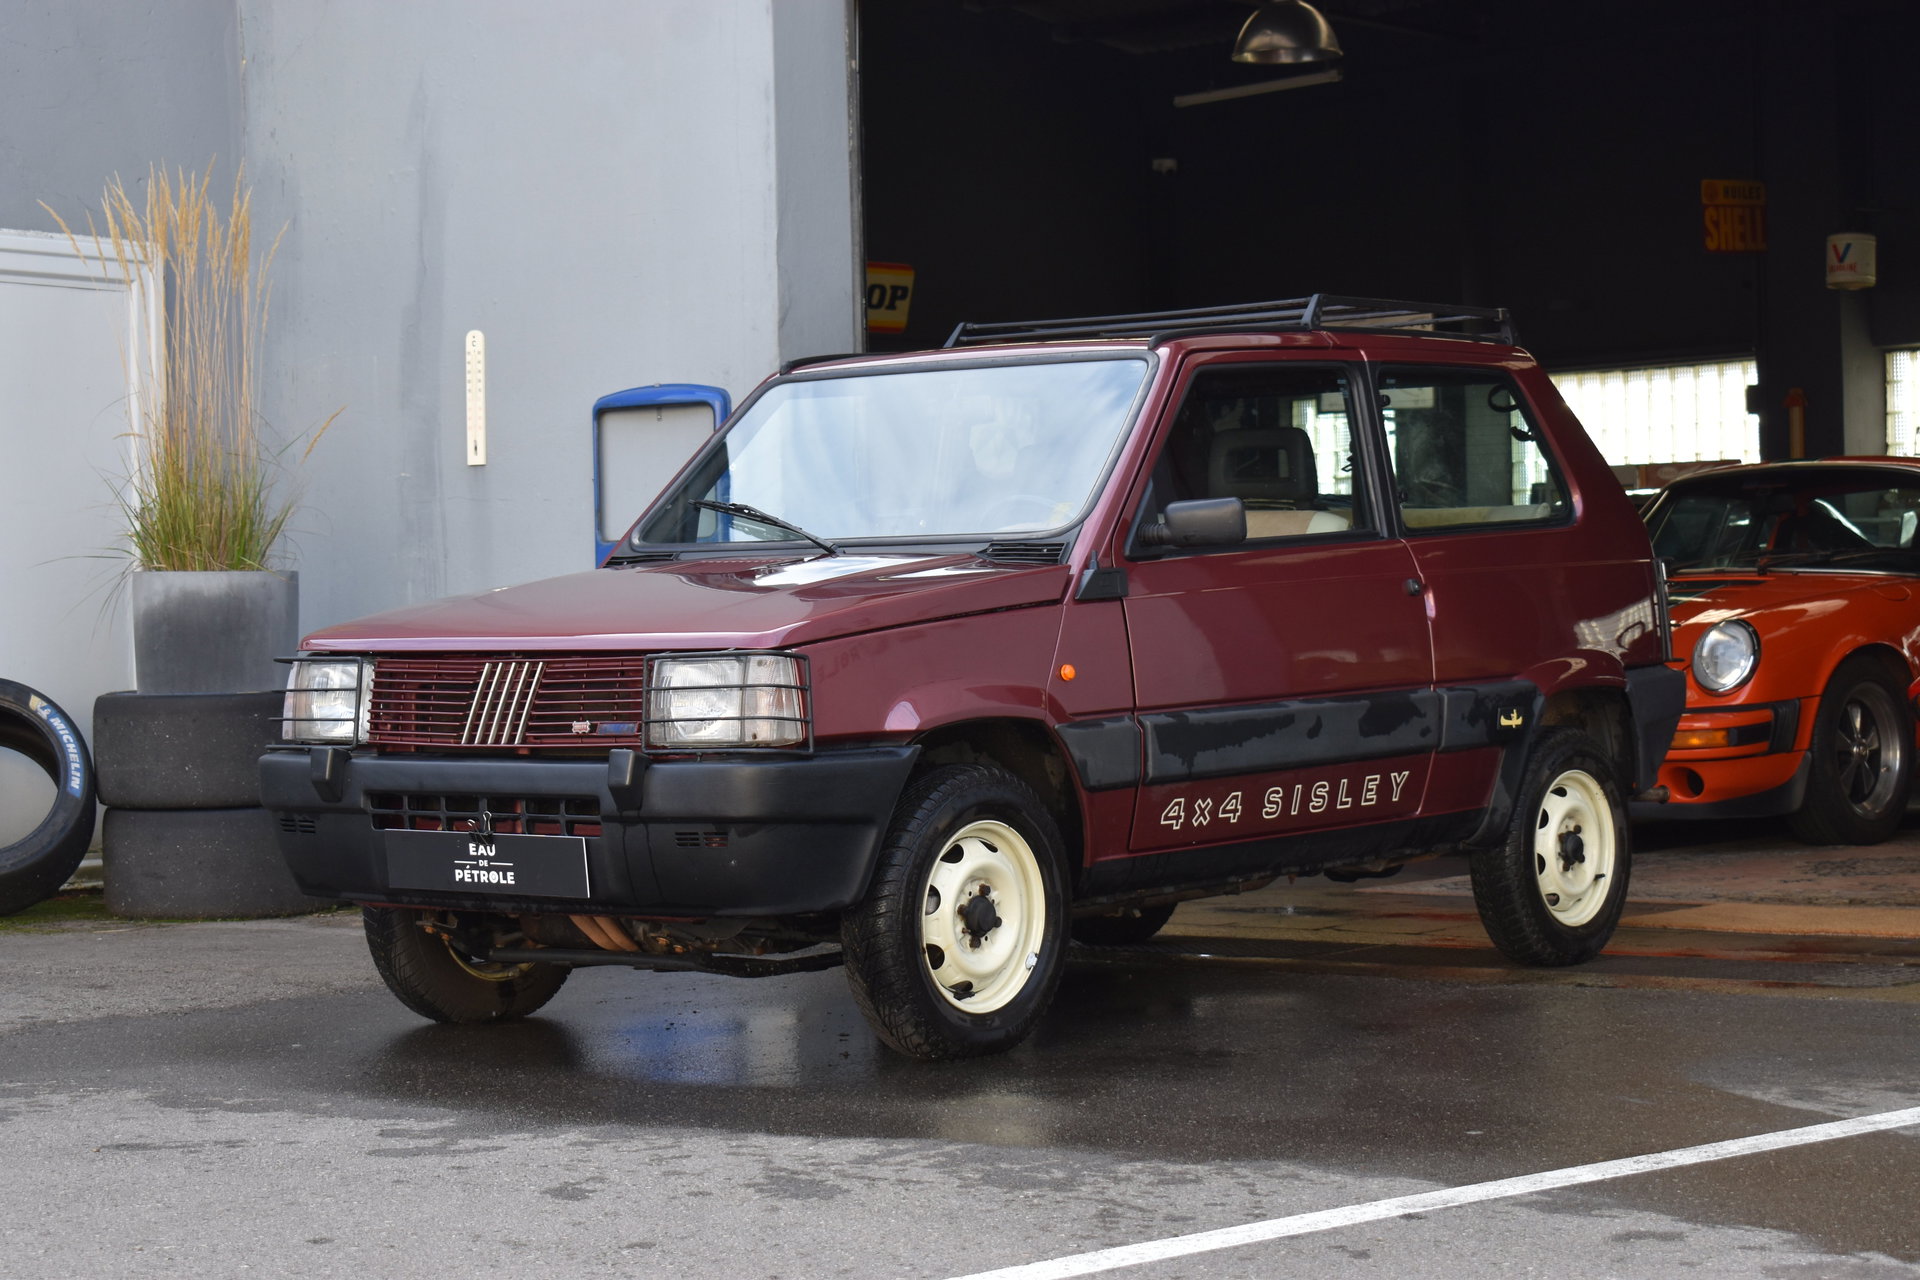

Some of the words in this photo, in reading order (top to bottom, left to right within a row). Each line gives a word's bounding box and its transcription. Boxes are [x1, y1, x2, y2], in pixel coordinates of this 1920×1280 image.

[1704, 206, 1767, 251] SHELL
[49, 717, 81, 790] MICHELIN
[1262, 771, 1410, 819] SISLEY
[468, 843, 496, 857] EAU
[454, 865, 515, 884] PÉTROLE
